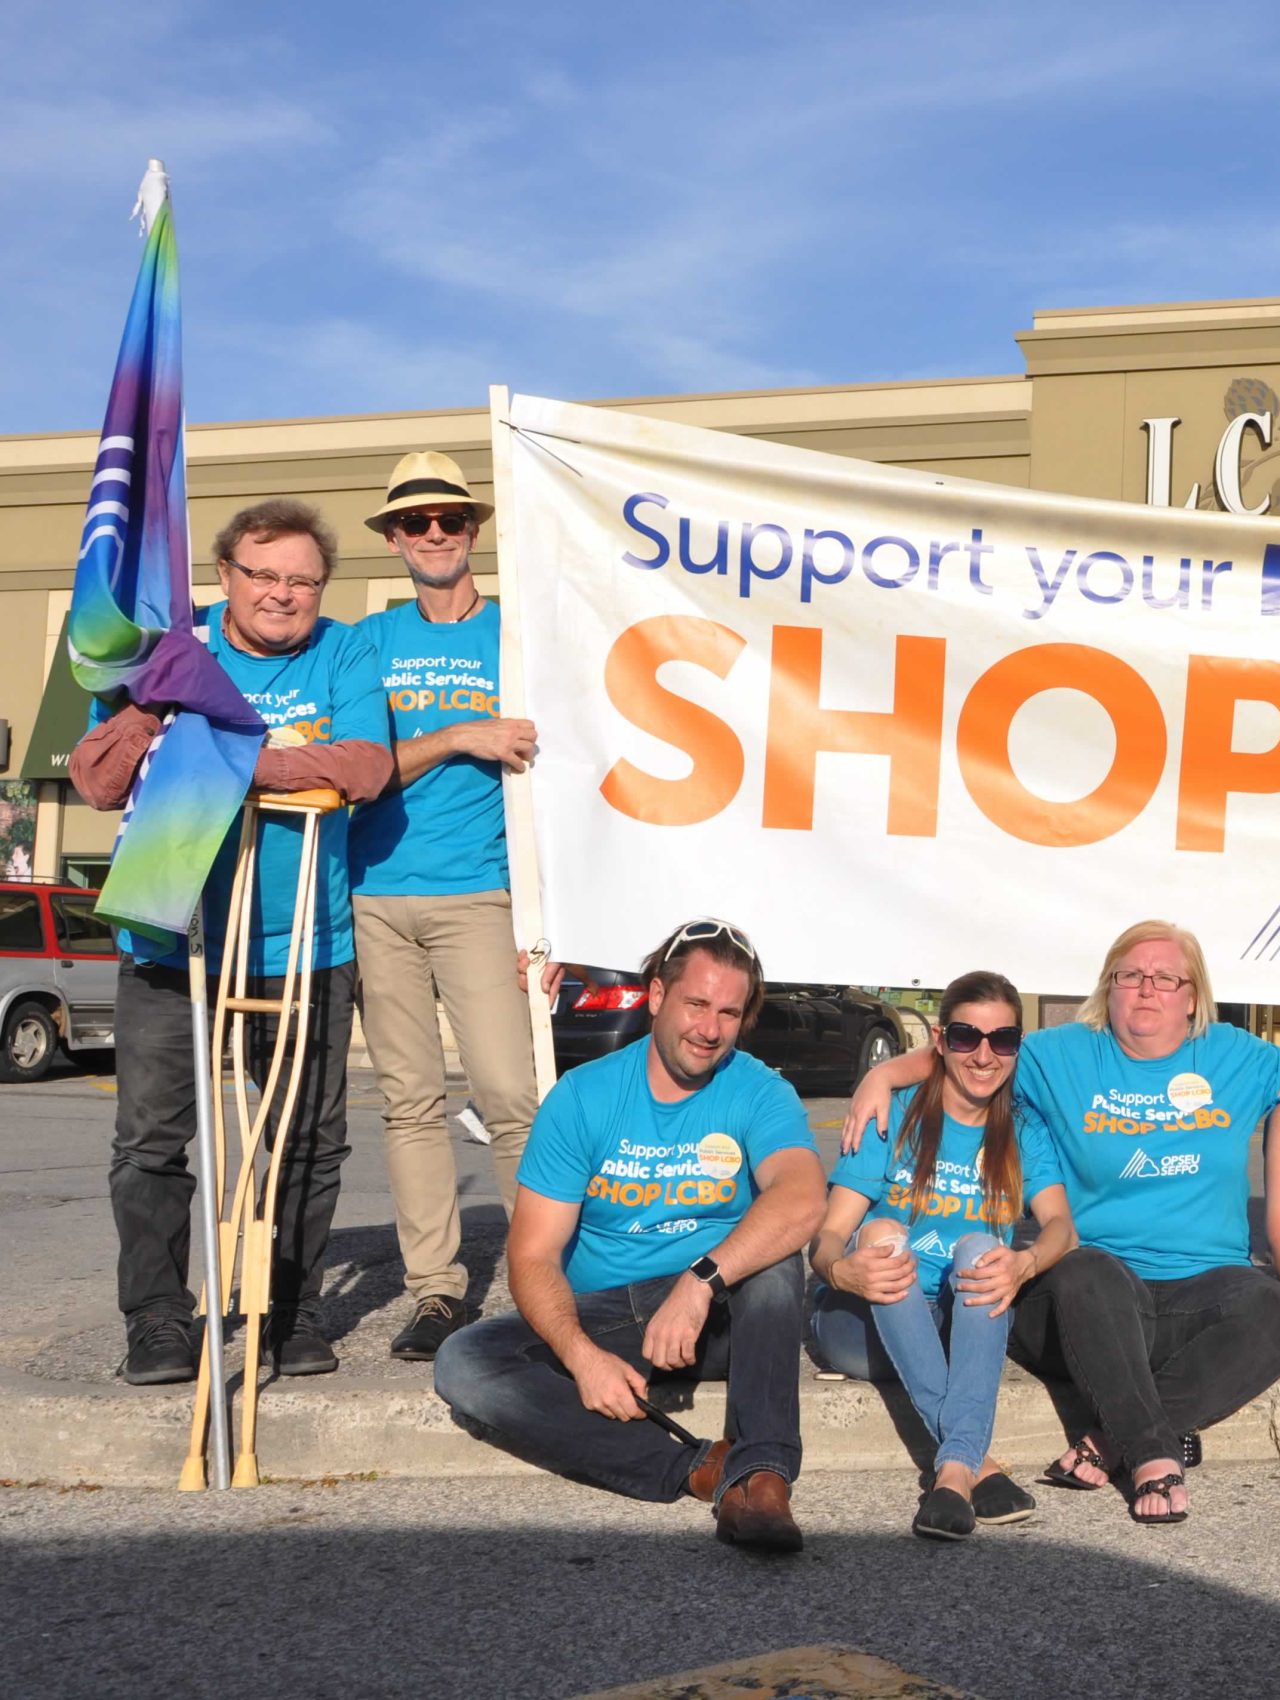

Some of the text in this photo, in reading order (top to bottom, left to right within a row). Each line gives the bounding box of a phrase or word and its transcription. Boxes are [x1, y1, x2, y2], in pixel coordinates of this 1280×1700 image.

[621, 492, 995, 603] Support
[1022, 546, 1232, 620] your
[391, 656, 482, 671] Support your
[382, 672, 494, 690] ublic Services
[389, 689, 435, 712] OP
[1109, 1089, 1165, 1106] Support
[1084, 1111, 1157, 1134] SHOP
[677, 1142, 700, 1158] you
[1161, 1153, 1200, 1166] OPSEU
[935, 1160, 970, 1178] pport
[1161, 1164, 1199, 1176] SEFPO
[586, 1175, 737, 1206] SHOP LCBO
